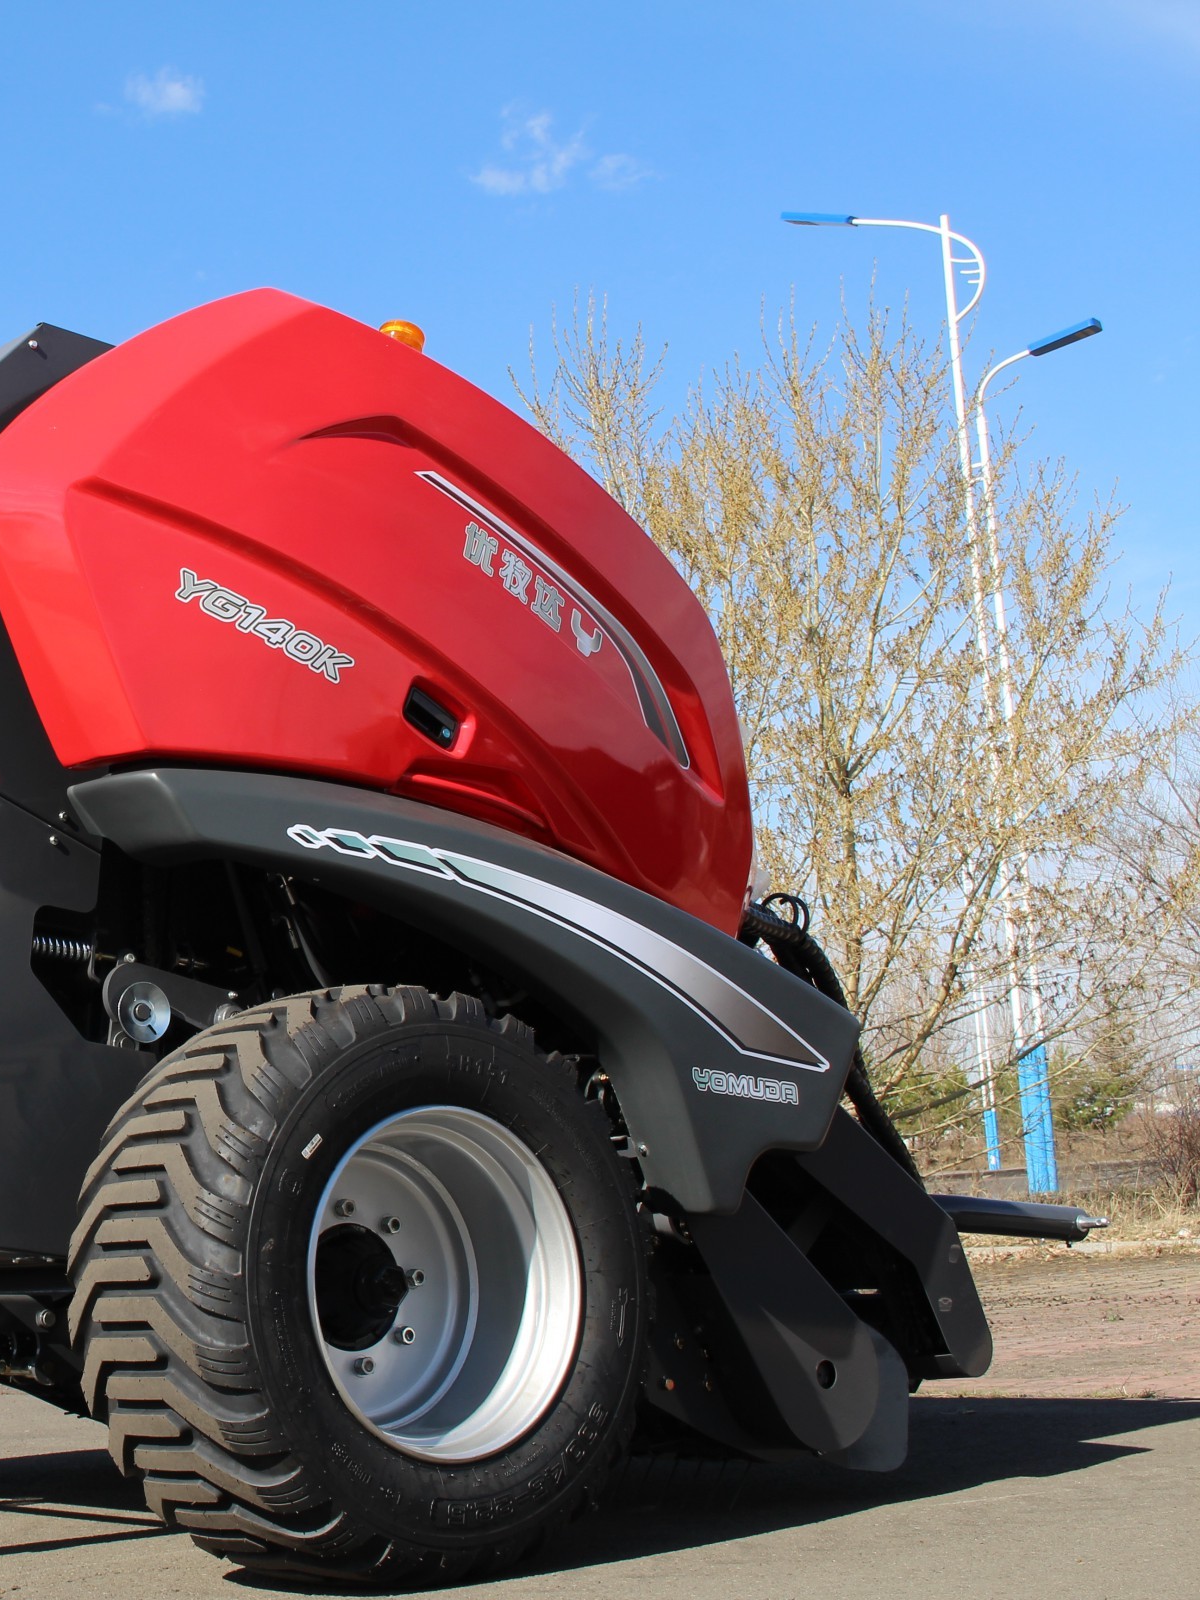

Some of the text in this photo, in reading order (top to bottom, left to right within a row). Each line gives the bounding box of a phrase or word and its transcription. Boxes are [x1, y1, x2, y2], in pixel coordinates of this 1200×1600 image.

[175, 567, 355, 684] YG140K
[463, 521, 565, 632] 优牧达
[692, 1067, 799, 1105] YOMUDA
